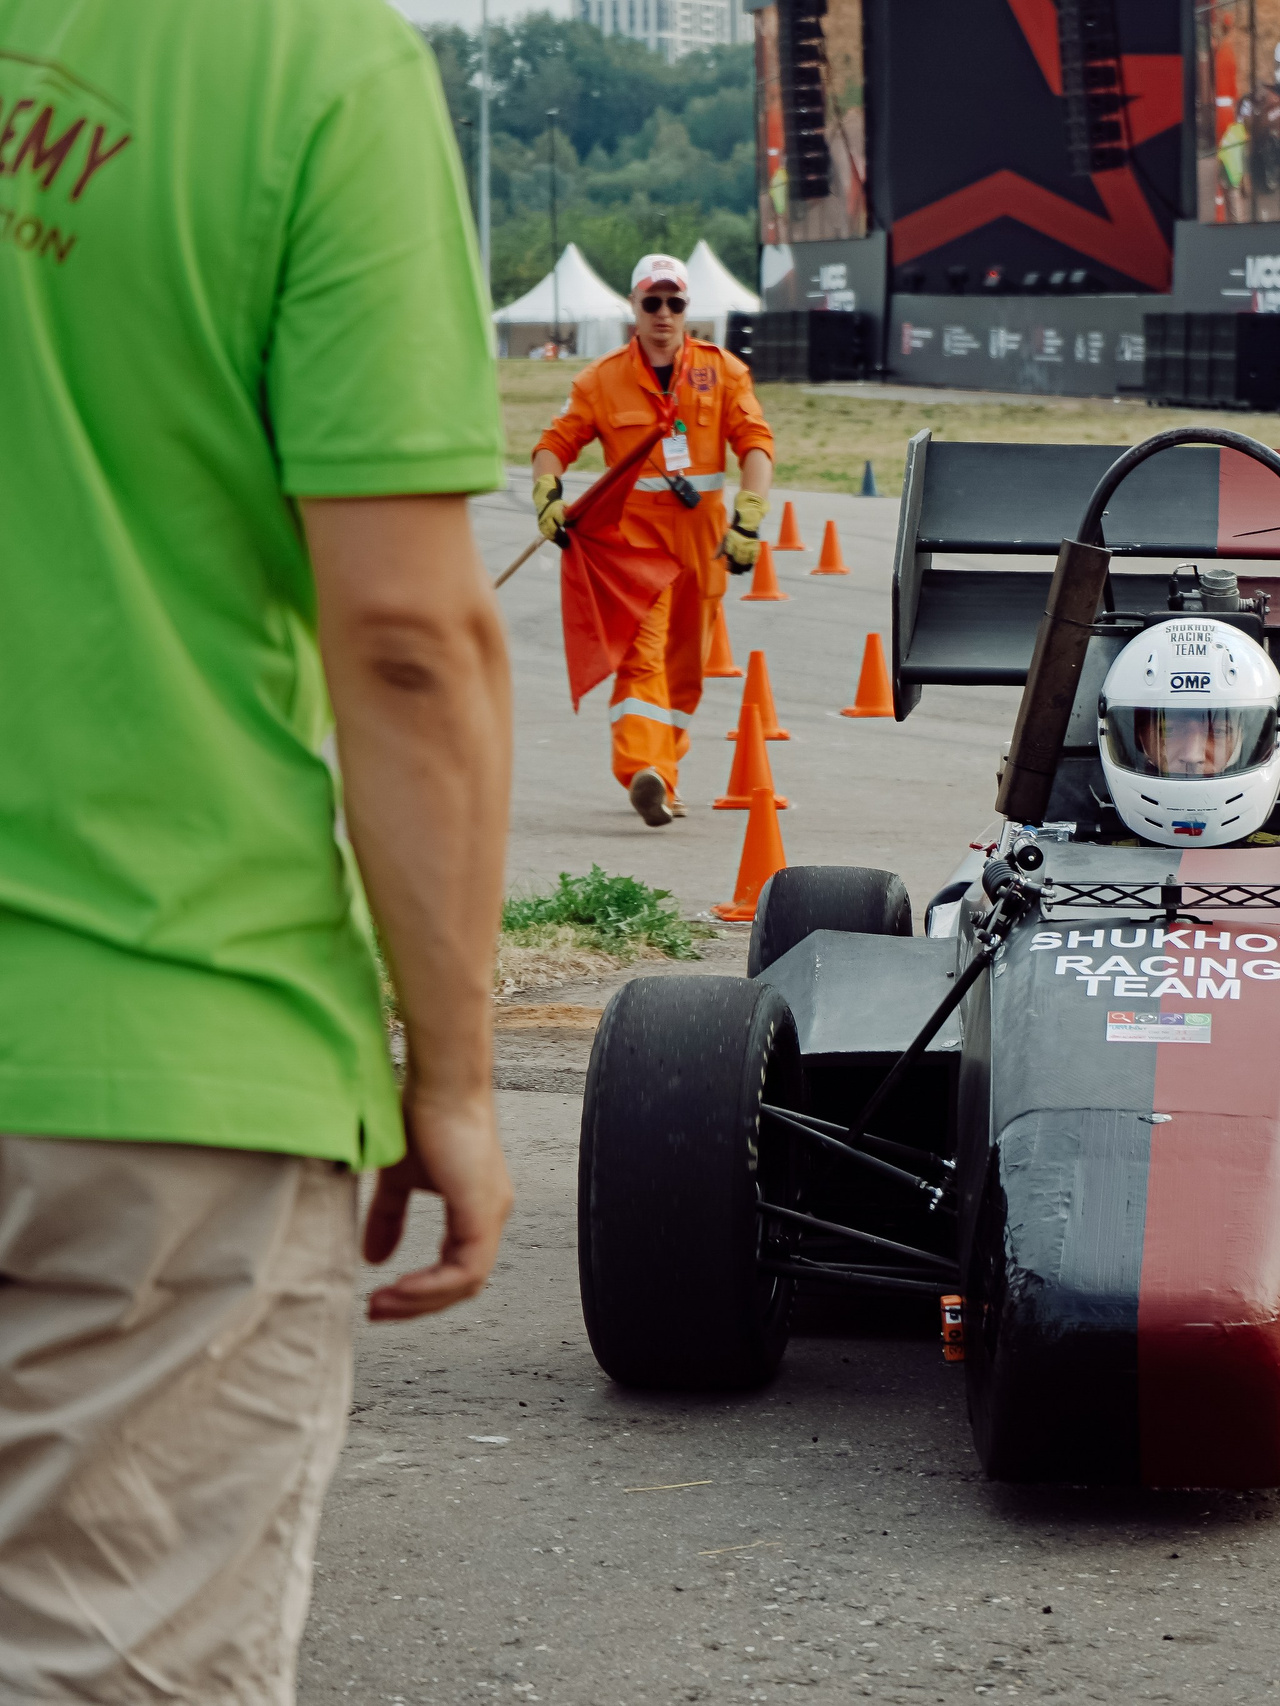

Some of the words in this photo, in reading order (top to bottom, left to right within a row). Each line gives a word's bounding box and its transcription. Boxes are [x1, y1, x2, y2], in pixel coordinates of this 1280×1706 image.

[0, 207, 77, 265] ION
[1165, 624, 1216, 633] SHUKHOV
[1170, 632, 1212, 643] RACING
[1176, 643, 1207, 656] TEAM
[1170, 675, 1211, 690] OMP
[1076, 975, 1241, 1000] TEAM
